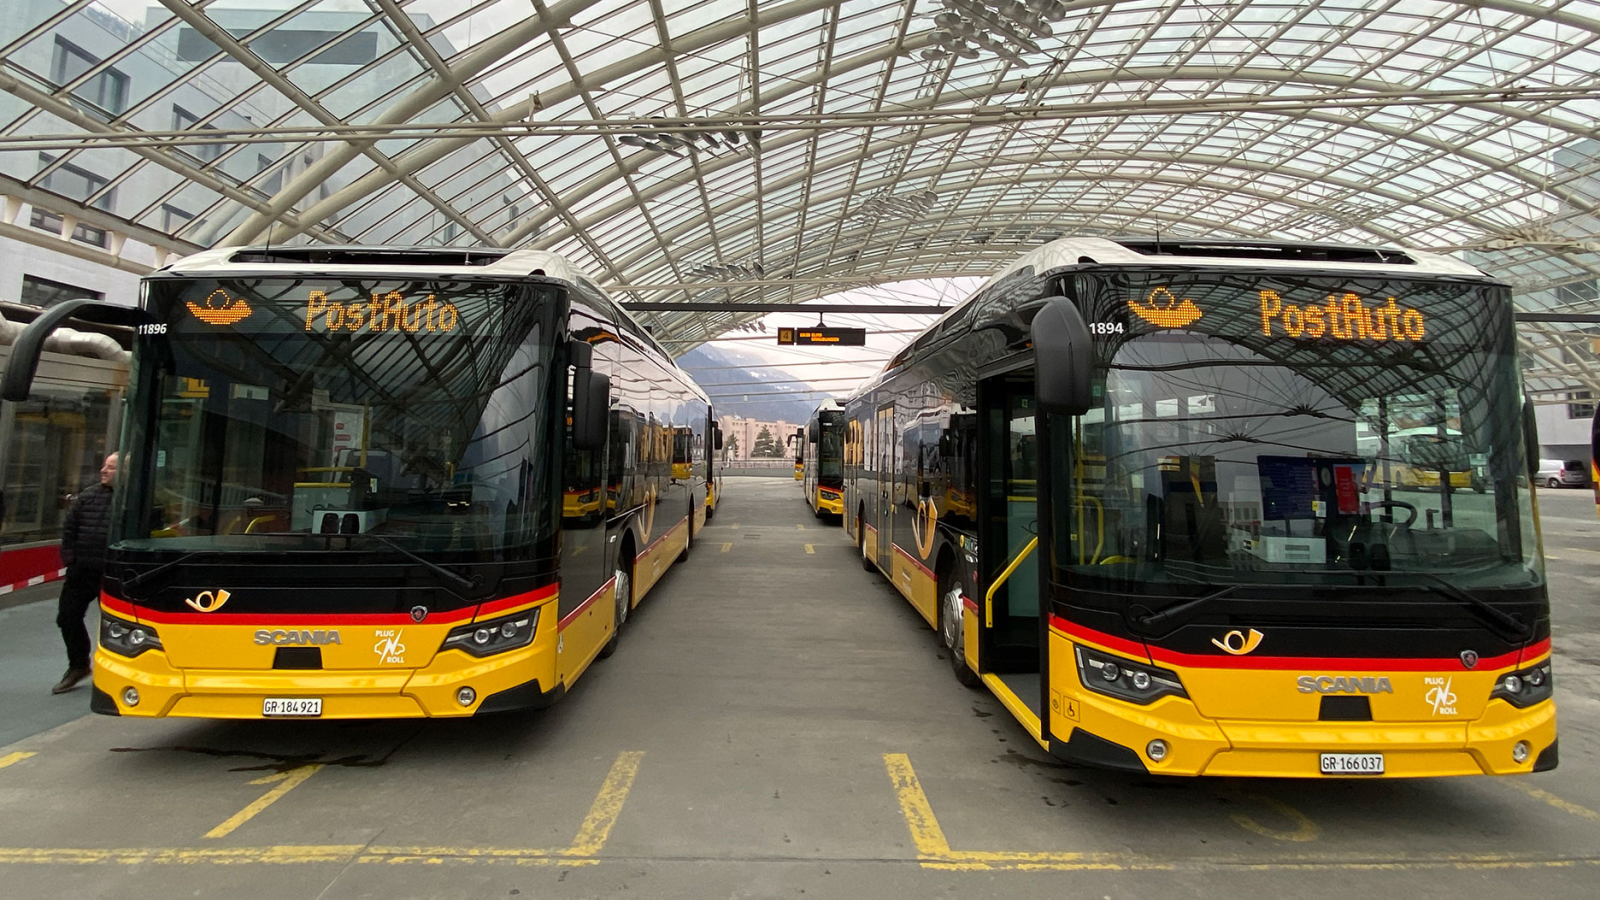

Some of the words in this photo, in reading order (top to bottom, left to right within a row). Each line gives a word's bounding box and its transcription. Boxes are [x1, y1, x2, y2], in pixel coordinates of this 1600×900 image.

[304, 290, 457, 332] PostAuto
[1260, 290, 1425, 341] PostAuto
[137, 323, 168, 335] 11896
[253, 629, 342, 646] SCANIA
[375, 629, 395, 637] PLUG
[386, 656, 405, 664] ROLL
[1296, 675, 1394, 694] SCANIA
[1424, 677, 1444, 685] PLUG
[1439, 707, 1458, 715] ROLL
